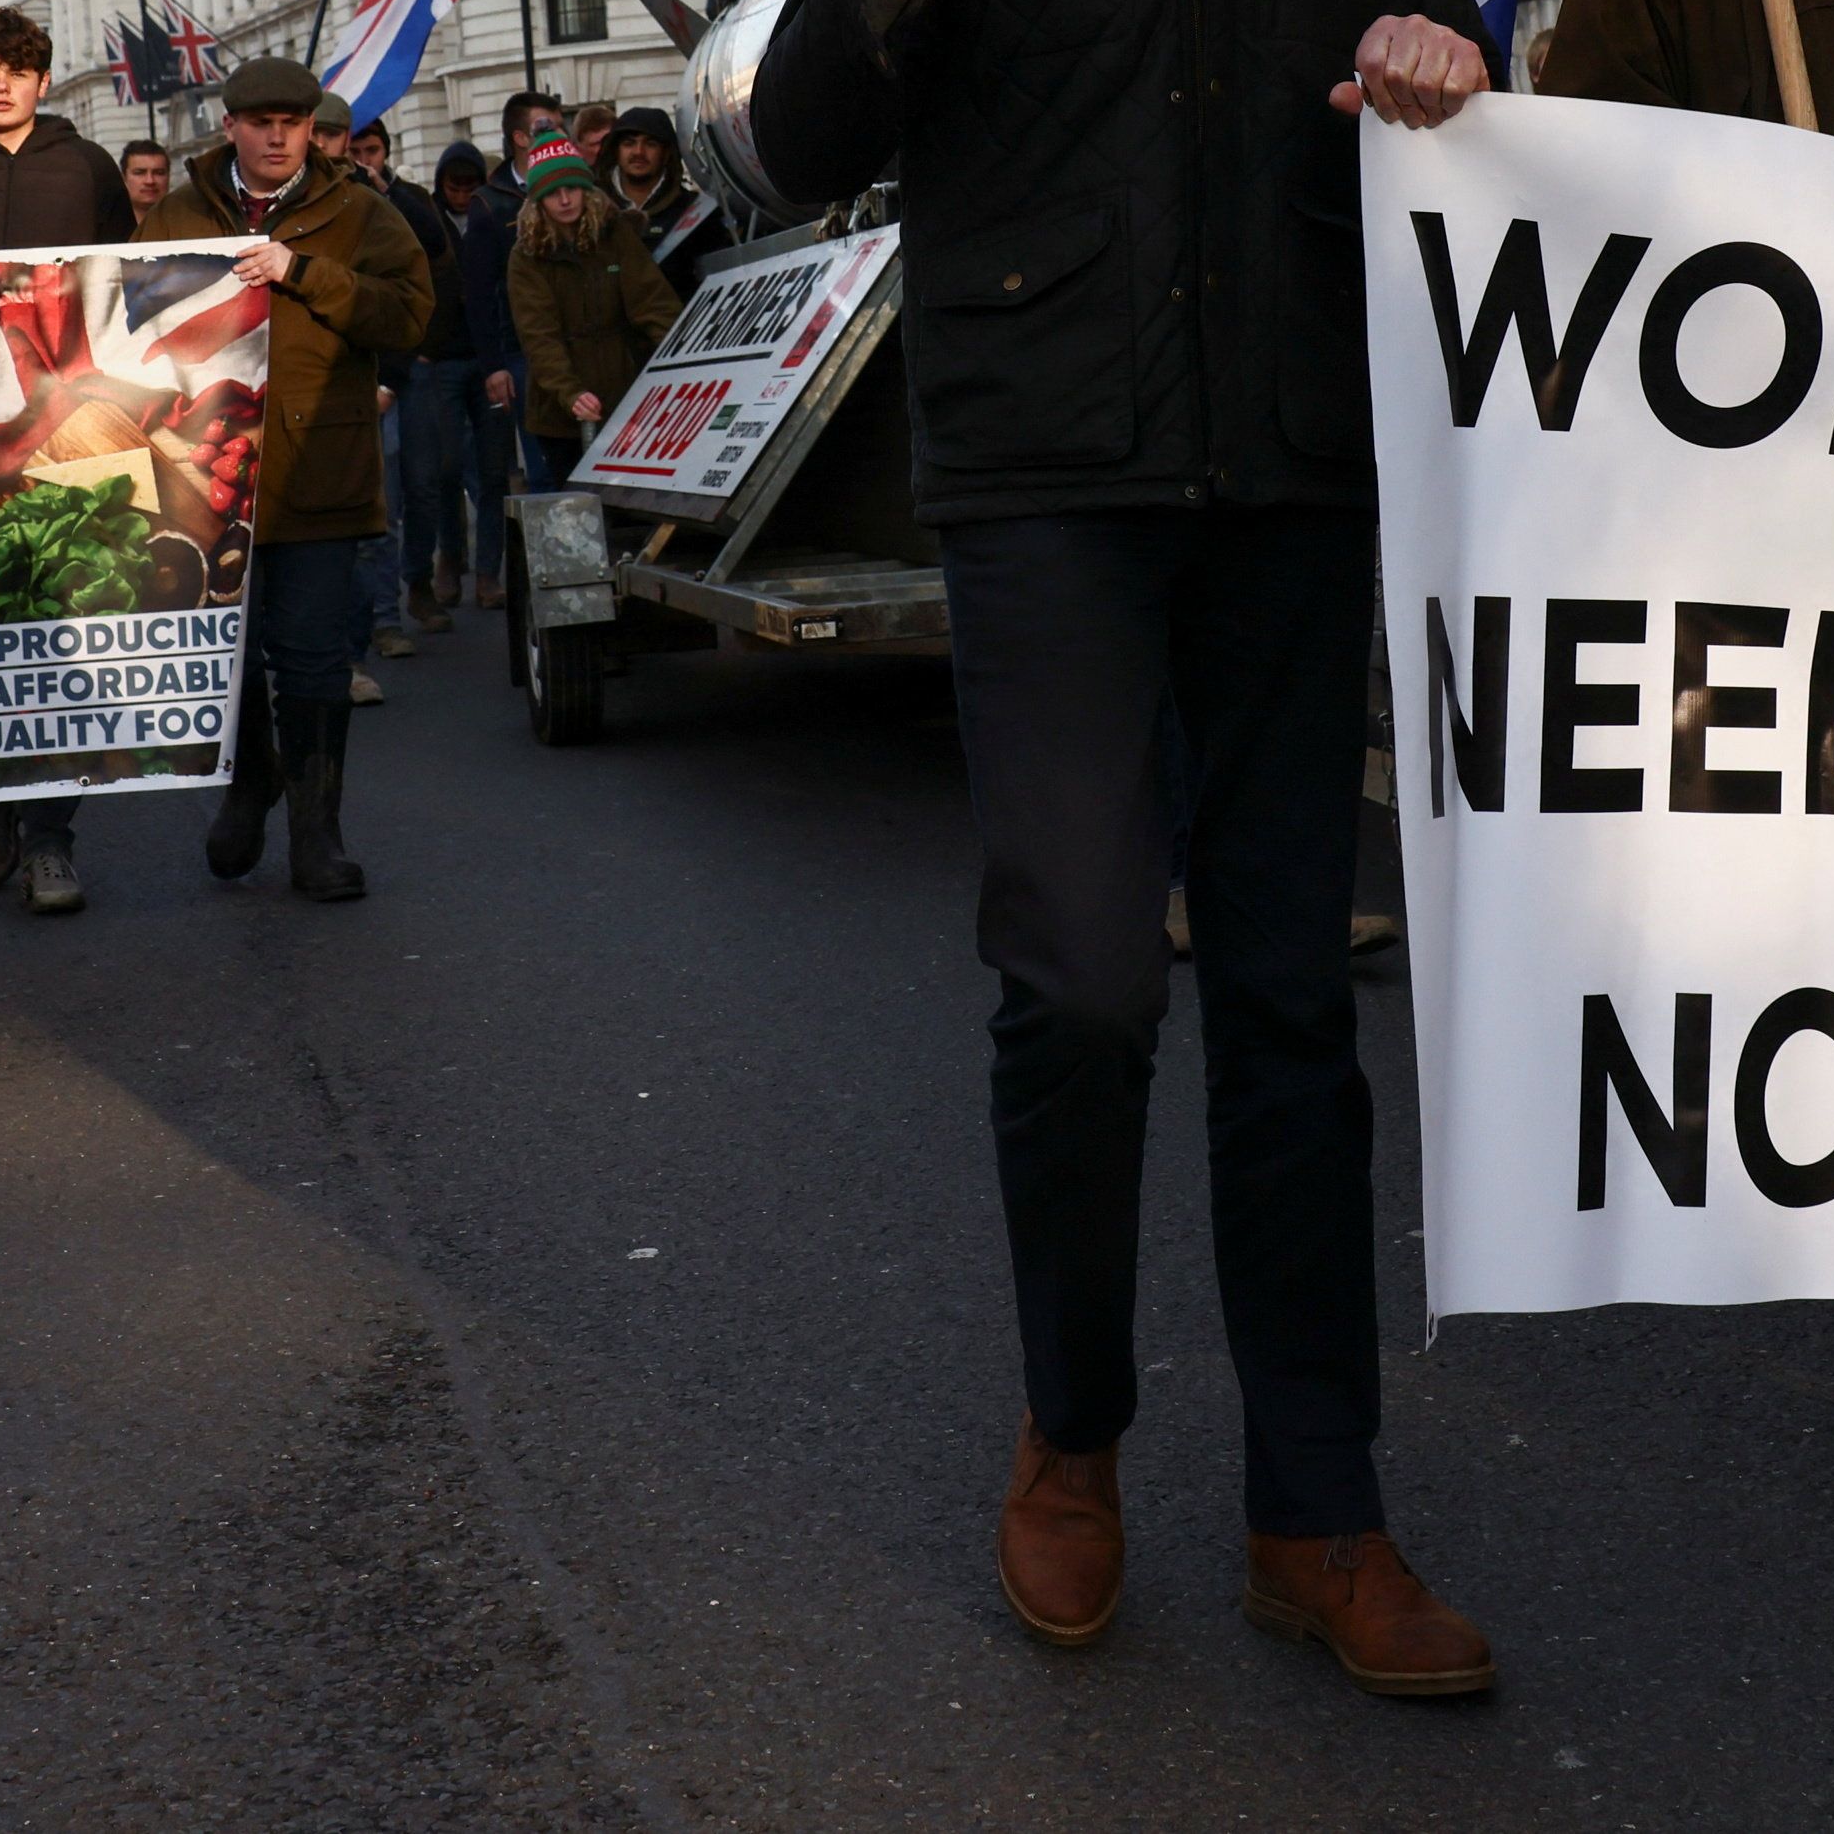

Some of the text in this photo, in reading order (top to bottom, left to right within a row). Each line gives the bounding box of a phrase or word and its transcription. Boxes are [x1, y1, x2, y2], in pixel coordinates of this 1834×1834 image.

[656, 284, 724, 360] NO
[685, 257, 835, 355] FARMERS
[603, 379, 733, 460] NO FOOD
[135, 703, 228, 743] FOO
